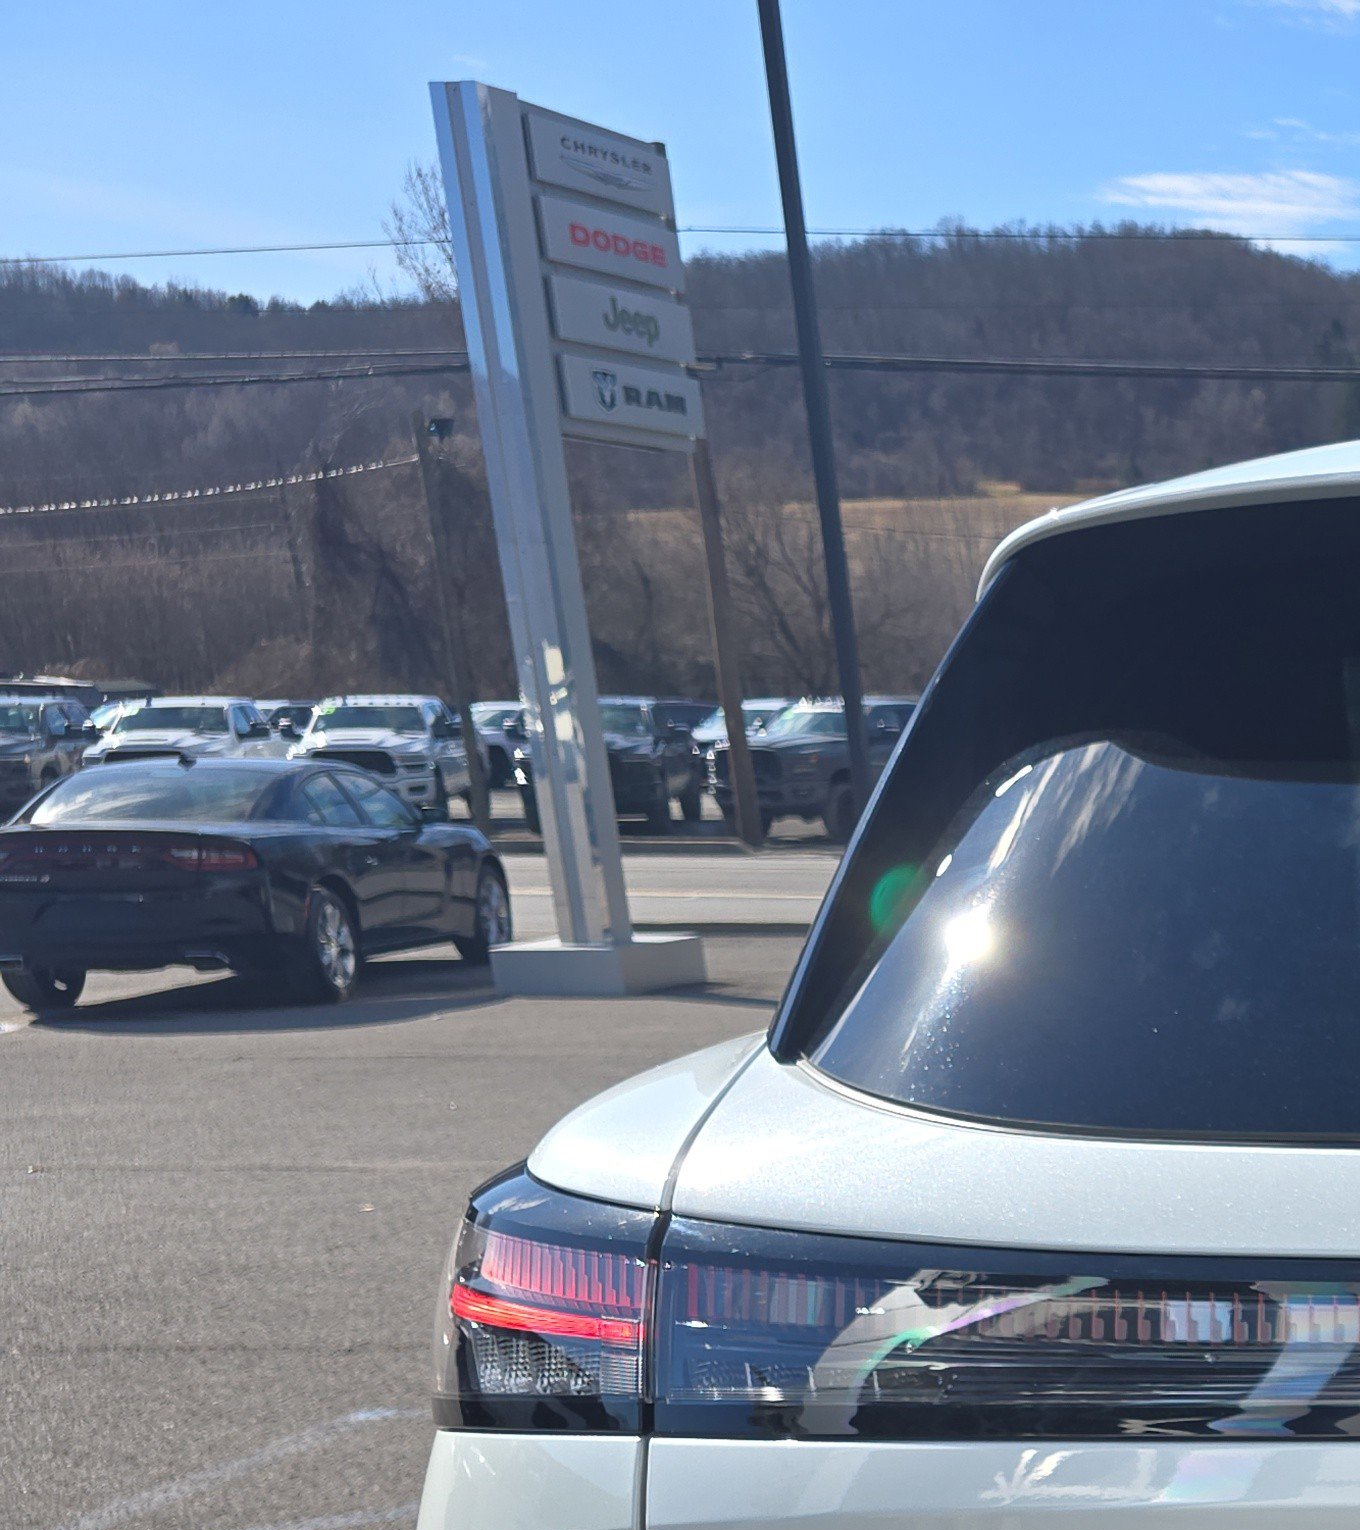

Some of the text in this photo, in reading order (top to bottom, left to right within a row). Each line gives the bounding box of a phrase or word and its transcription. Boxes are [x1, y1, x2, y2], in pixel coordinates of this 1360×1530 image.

[560, 136, 652, 174] CHRYSLER
[570, 222, 666, 267] DODGE
[603, 298, 659, 346] Jeep
[622, 386, 687, 415] RAM
